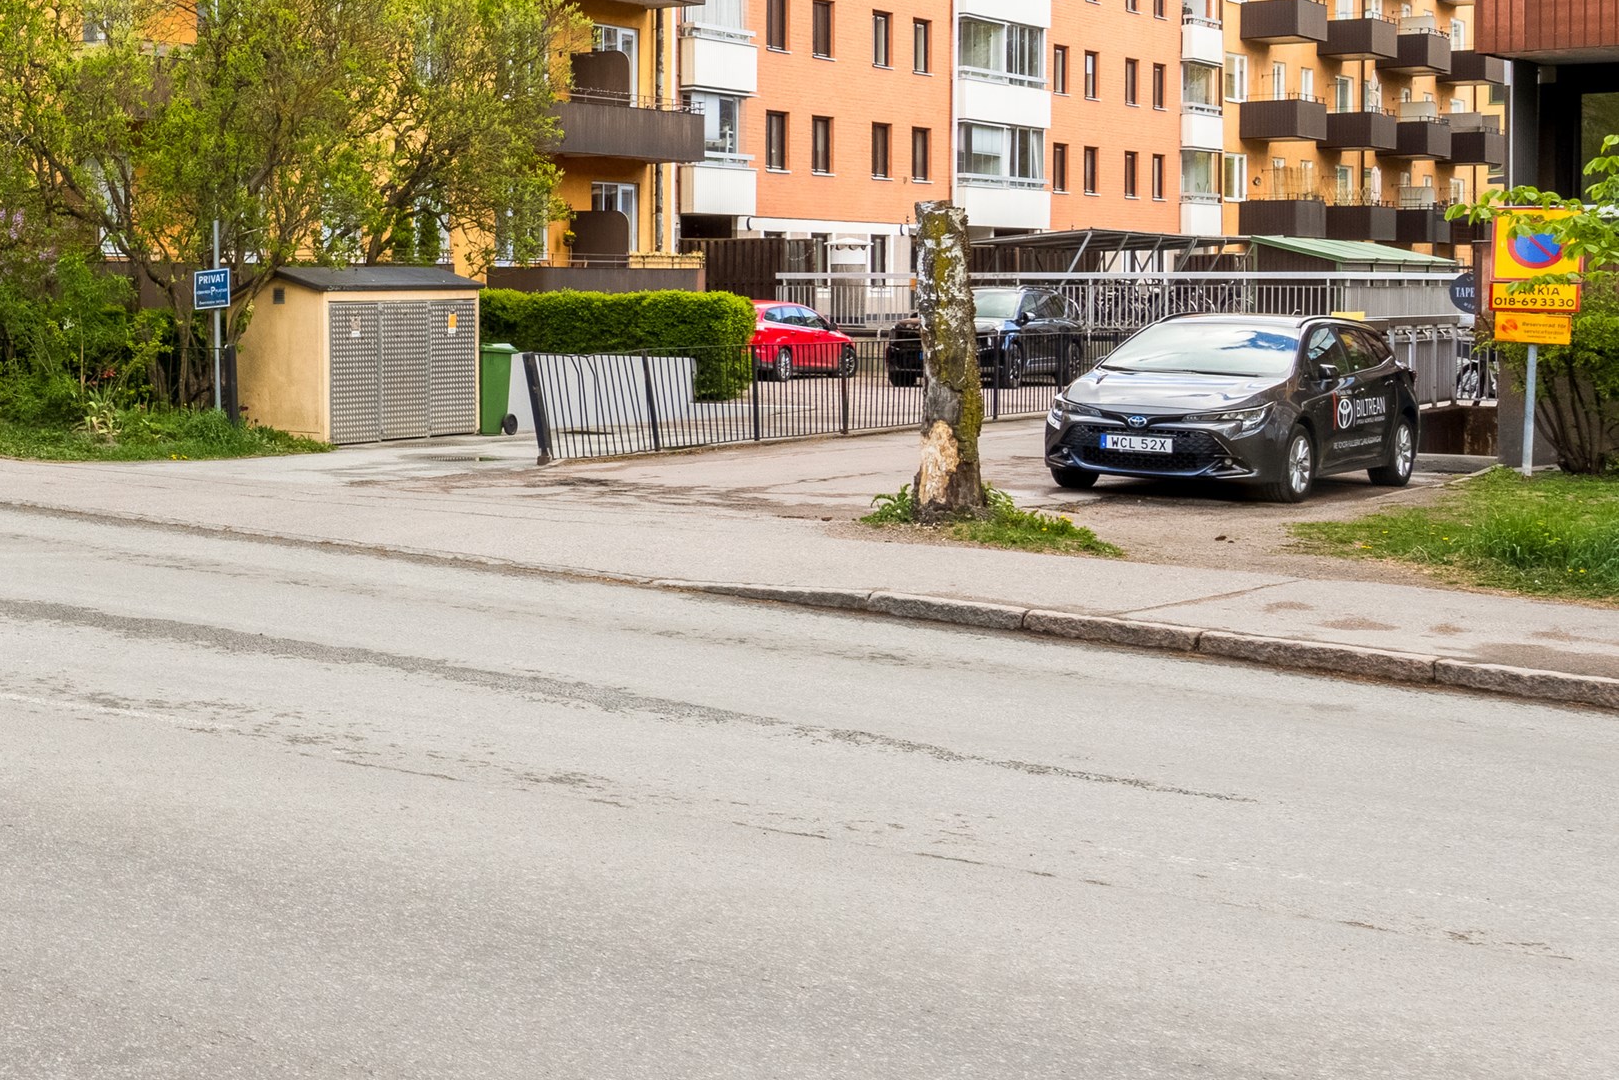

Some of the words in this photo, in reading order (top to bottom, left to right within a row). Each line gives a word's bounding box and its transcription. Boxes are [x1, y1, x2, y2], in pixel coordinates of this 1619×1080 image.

[198, 273, 225, 285] PRIVAT
[1455, 286, 1475, 298] TAPE
[1510, 286, 1560, 296] ARKIA
[1494, 297, 1537, 306] 018-69
[1540, 298, 1555, 307] 33
[1558, 298, 1575, 307] 30
[1356, 396, 1386, 417] BILTREAN
[1111, 436, 1135, 449] WCL
[1141, 438, 1167, 451] 52X
